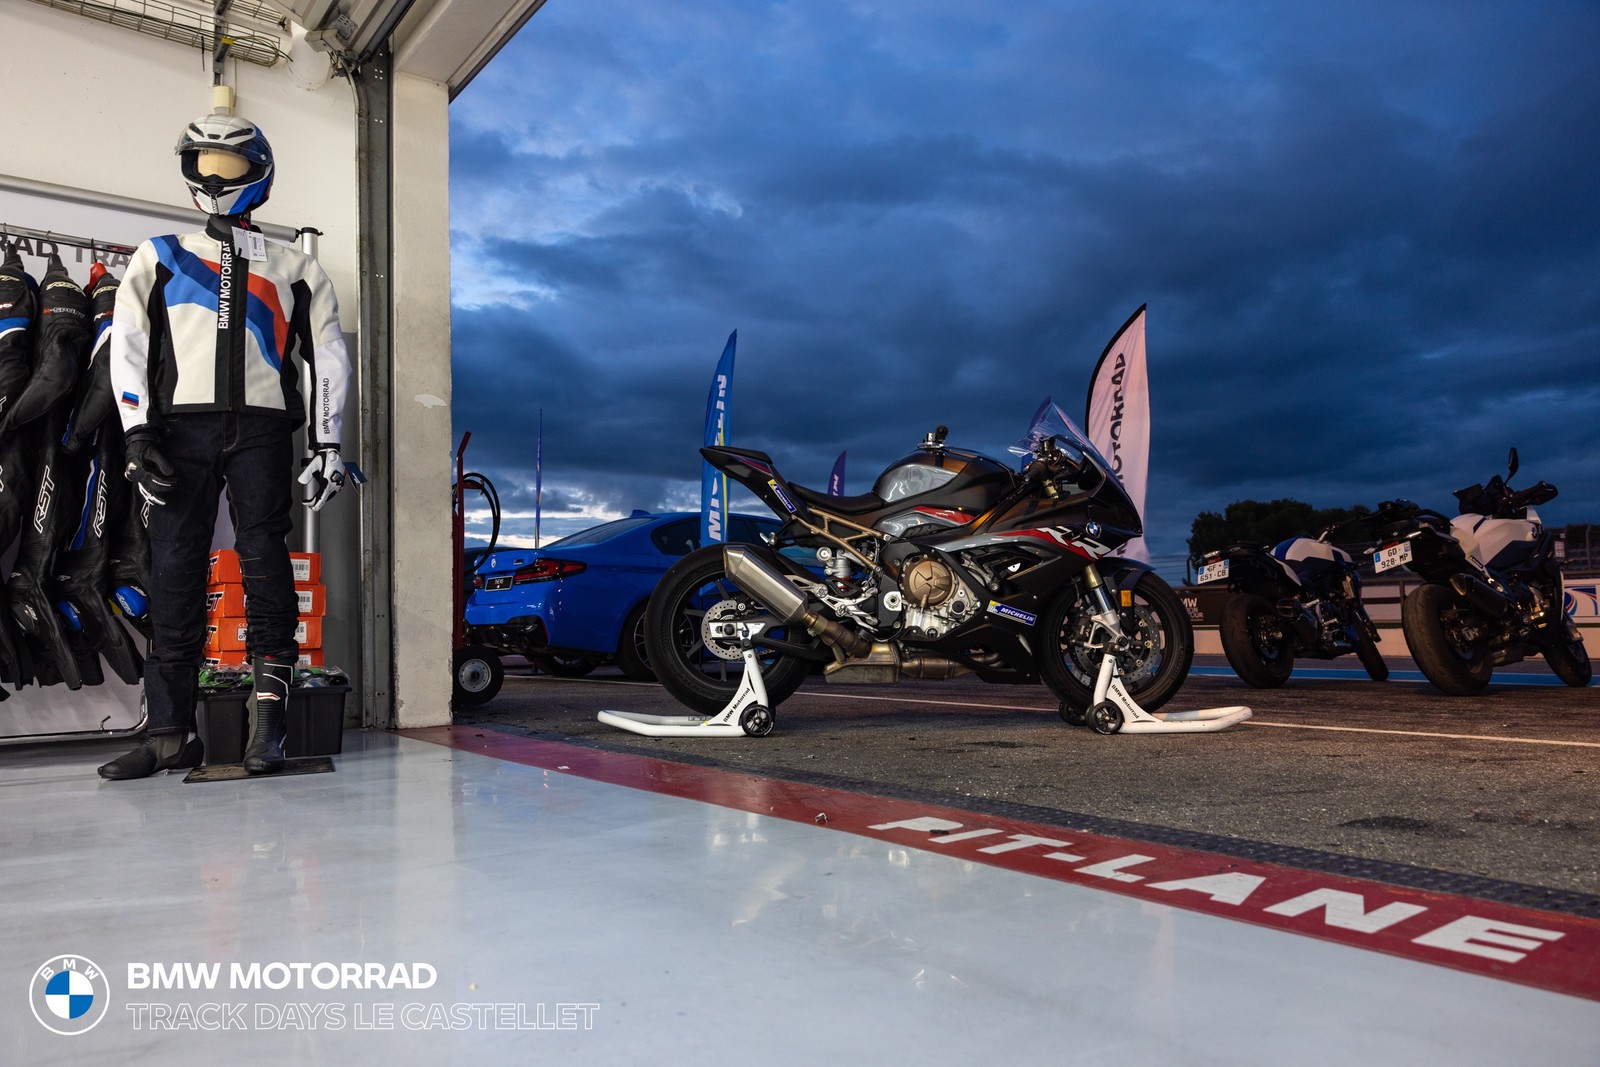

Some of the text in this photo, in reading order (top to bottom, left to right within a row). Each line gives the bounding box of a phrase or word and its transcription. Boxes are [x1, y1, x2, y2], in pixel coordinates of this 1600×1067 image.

[218, 300, 230, 329] BMW
[322, 378, 331, 434] BMW MOTORRAD
[33, 464, 55, 534] RST
[93, 468, 108, 538] RST
[205, 591, 224, 612] ST
[1000, 606, 1035, 622] MICHELIN
[1180, 597, 1198, 608] MW
